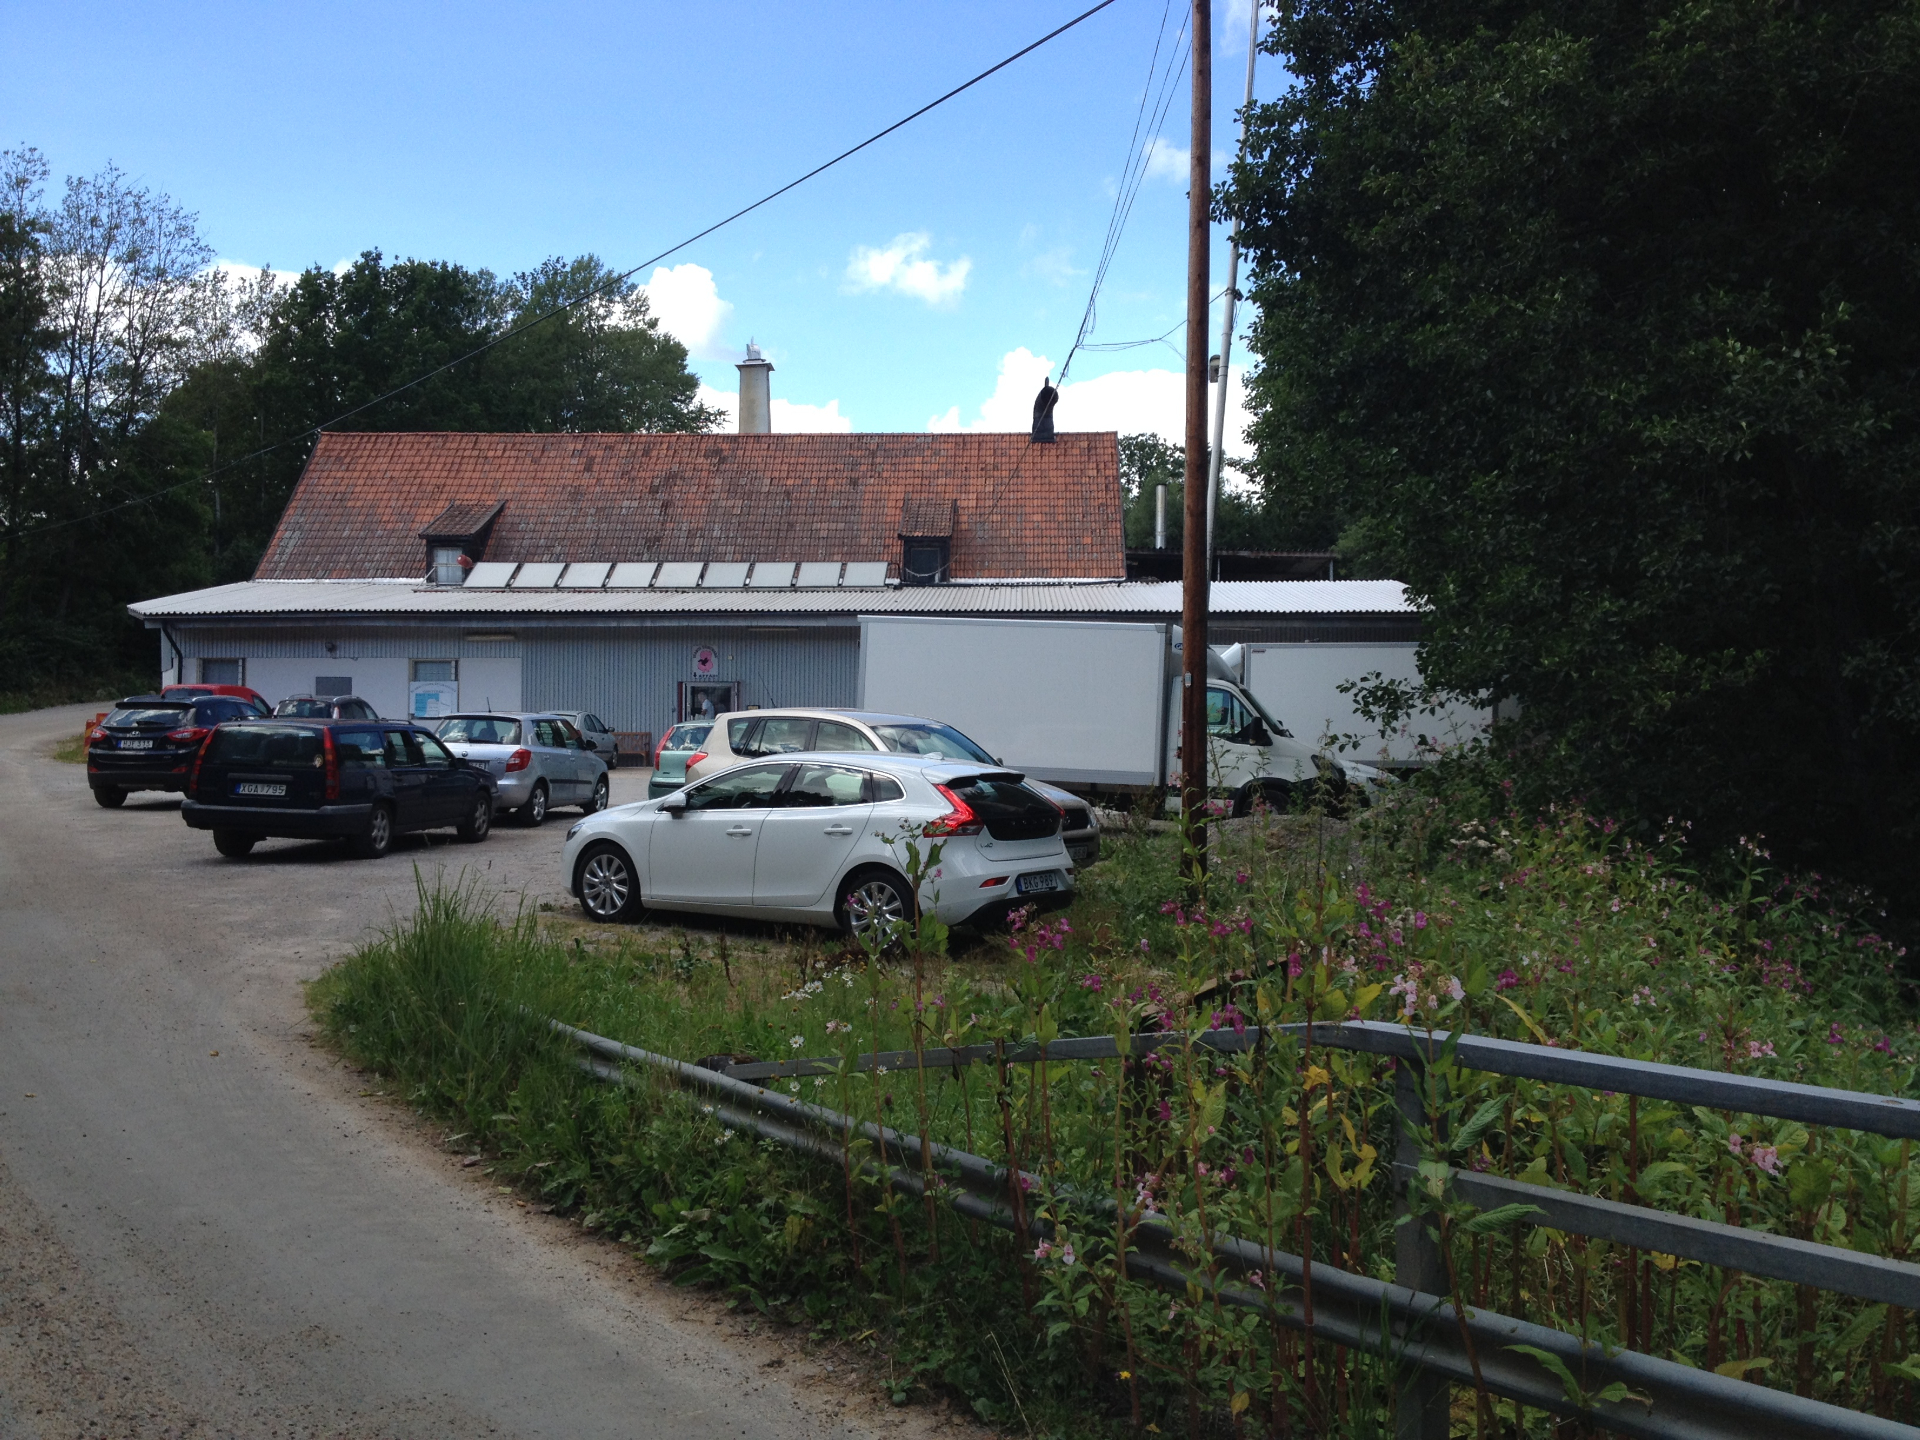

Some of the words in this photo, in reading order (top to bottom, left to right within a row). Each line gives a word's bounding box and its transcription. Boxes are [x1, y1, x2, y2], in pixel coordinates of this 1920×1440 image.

[241, 784, 259, 793] XGA
[265, 784, 285, 795] 795
[1023, 876, 1039, 890] BKG
